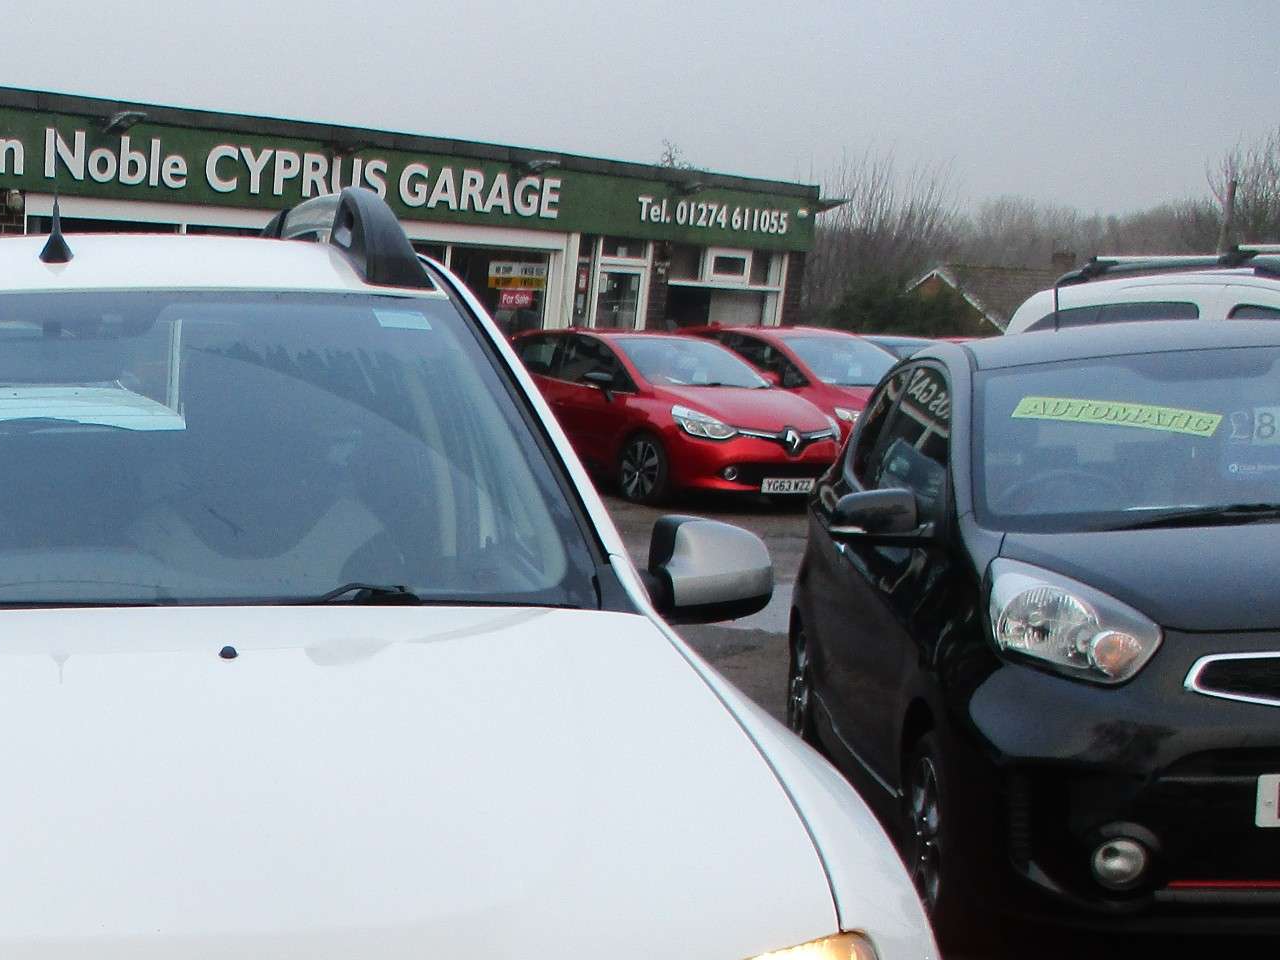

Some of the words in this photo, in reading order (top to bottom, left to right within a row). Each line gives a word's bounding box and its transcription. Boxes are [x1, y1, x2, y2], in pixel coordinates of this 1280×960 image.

[44, 127, 187, 189] Noble
[205, 145, 387, 200] CYPRUS
[399, 163, 561, 219] GARAGE
[638, 196, 670, 224] Tel.
[675, 201, 727, 229] 01274
[731, 206, 788, 235] 611055
[502, 294, 514, 304] For
[515, 294, 529, 305] Sale
[1023, 400, 1215, 432] AUTOMATIC
[766, 480, 792, 491] YG63
